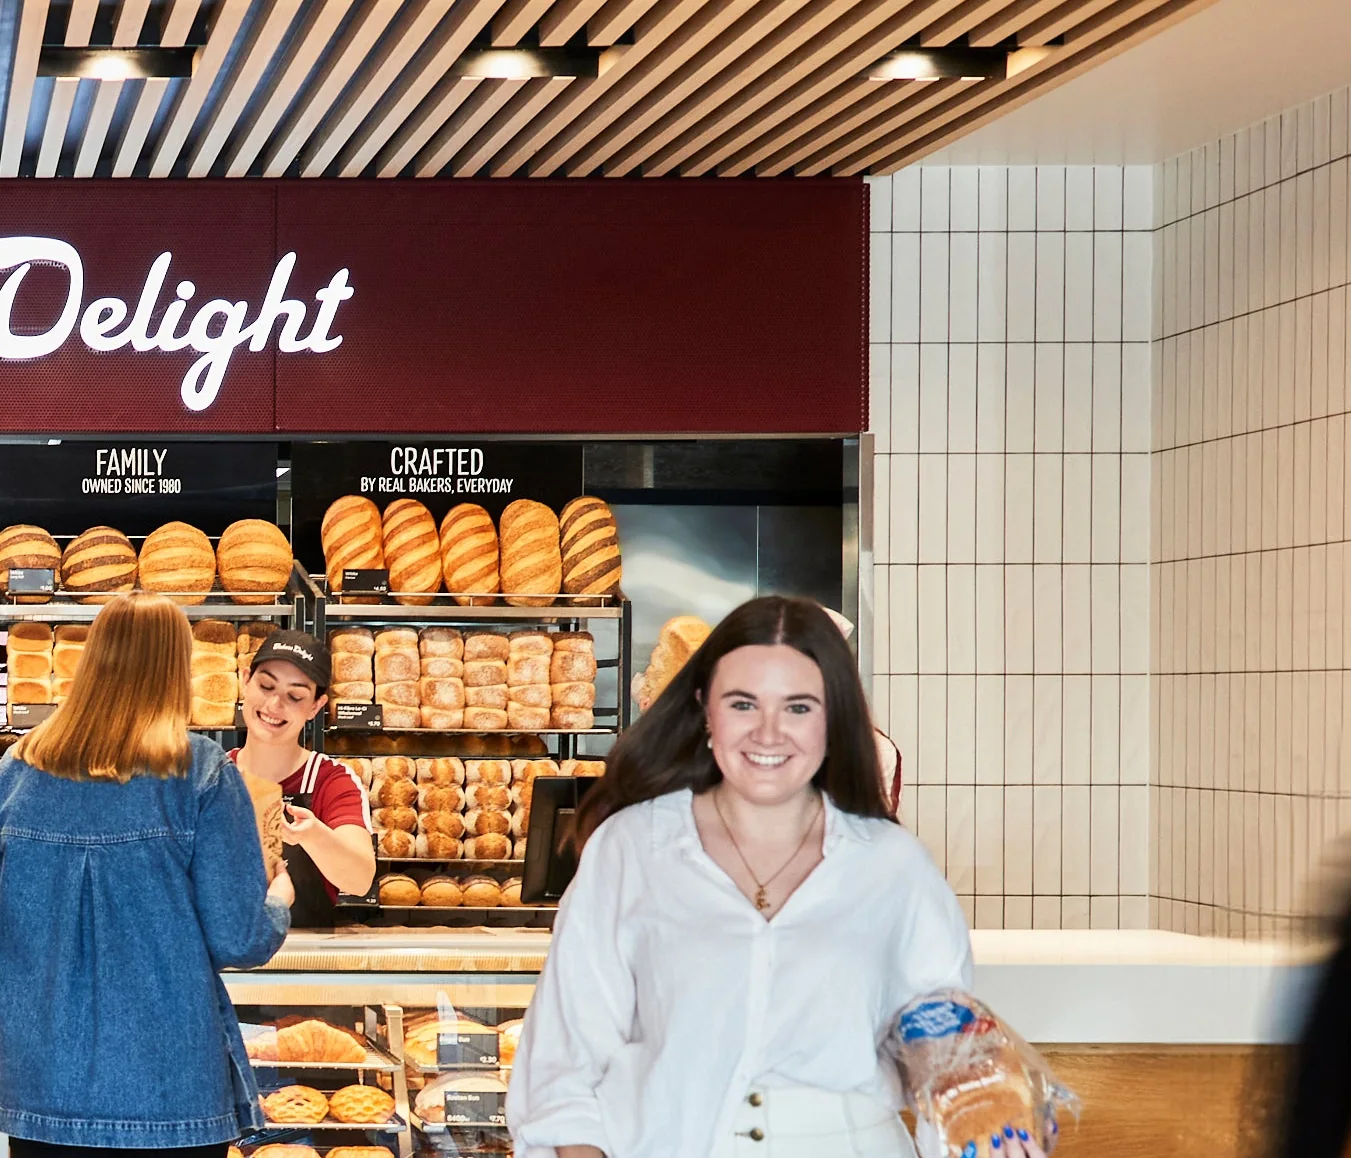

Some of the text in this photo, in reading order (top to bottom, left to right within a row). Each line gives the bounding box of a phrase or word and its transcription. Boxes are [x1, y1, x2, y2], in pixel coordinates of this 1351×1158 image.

[96, 447, 168, 476] FAMILY
[390, 446, 484, 476] CRAFTED
[81, 476, 182, 494] OWNED SINCE 1980
[360, 476, 514, 495] BY REAL BAKERS, EVERYDAY
[467, 1094, 481, 1102] Bun
